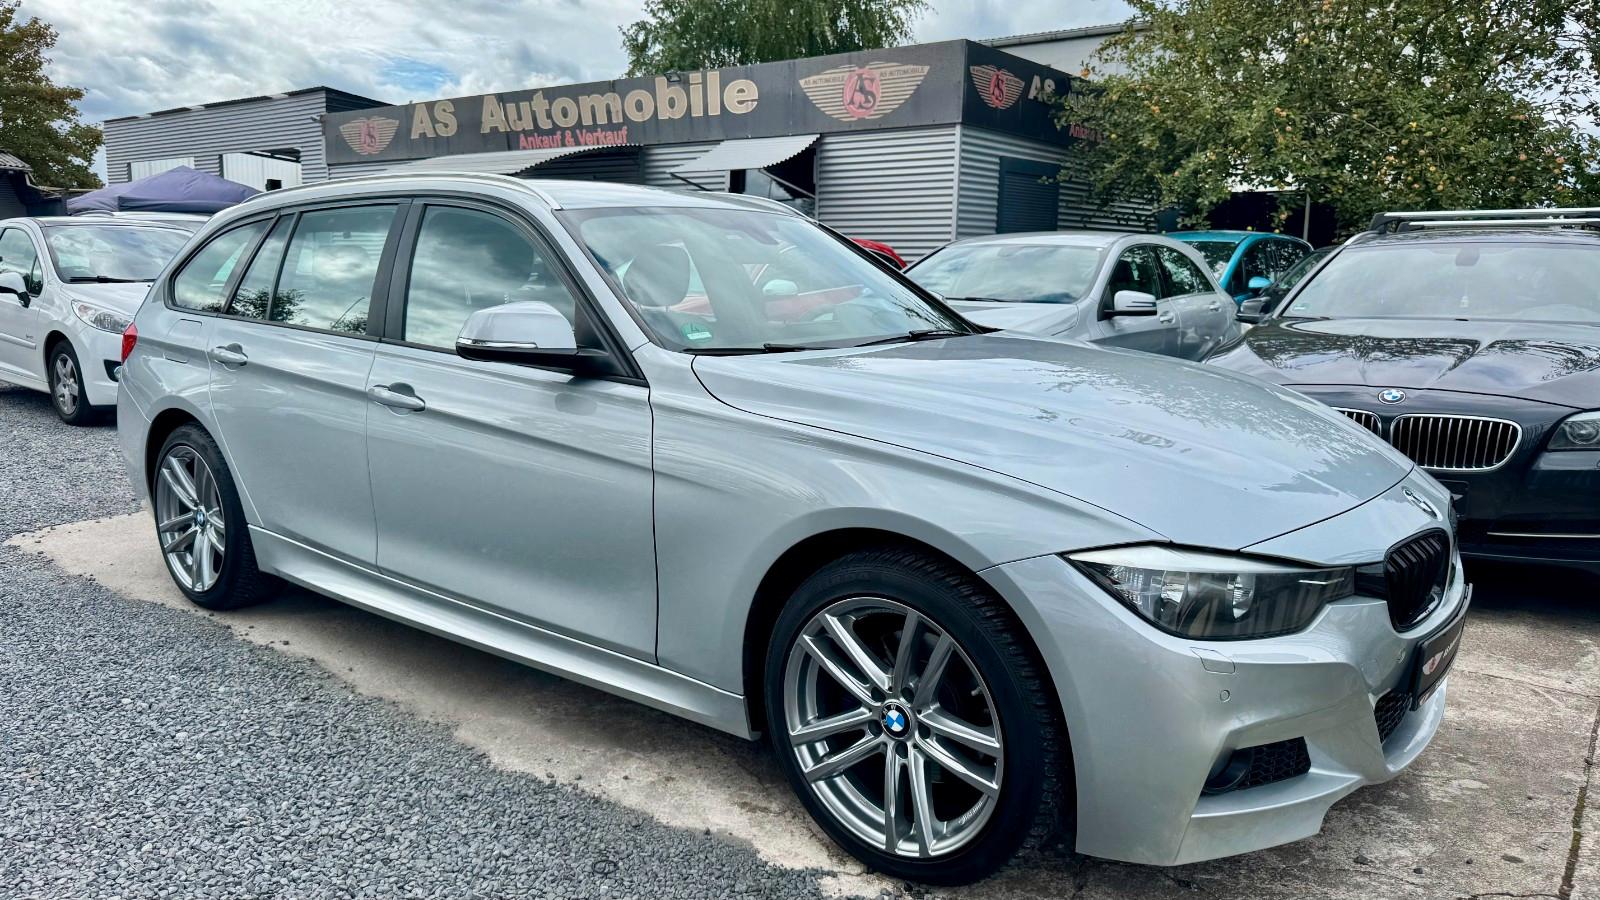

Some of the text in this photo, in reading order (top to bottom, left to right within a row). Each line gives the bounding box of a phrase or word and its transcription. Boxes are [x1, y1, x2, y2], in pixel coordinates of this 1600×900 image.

[411, 70, 759, 139] AS Automobile
[519, 125, 628, 150] Ankauf & Verkauf
